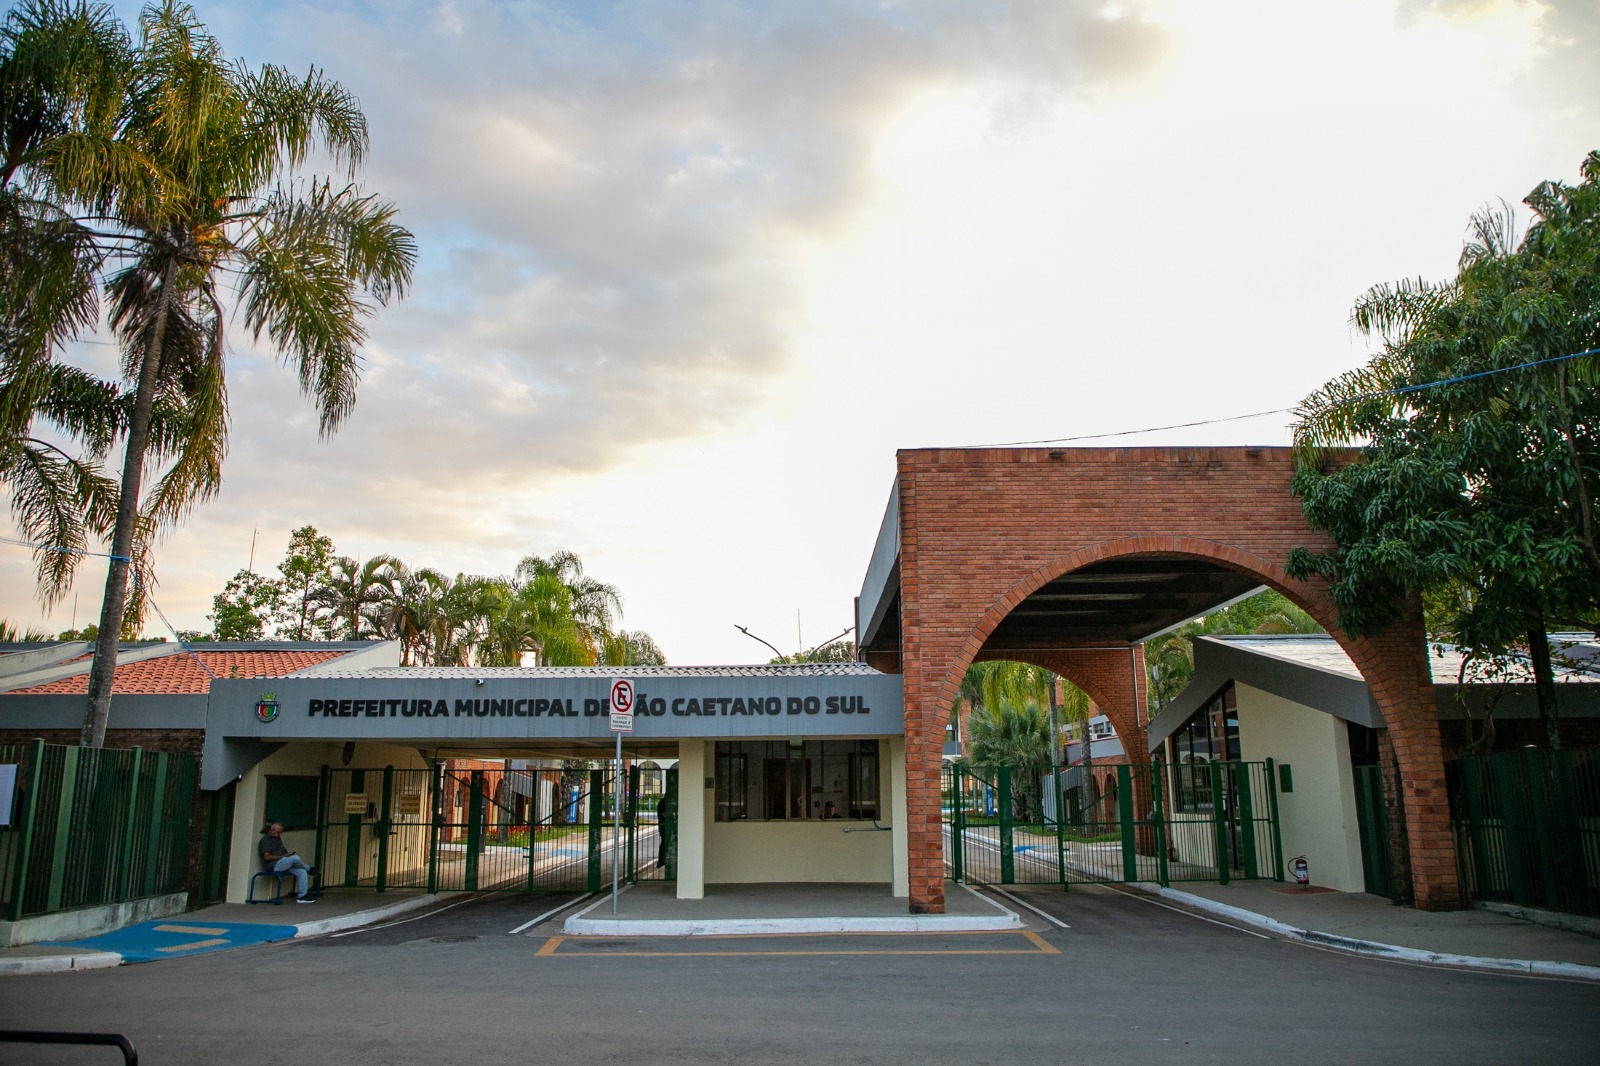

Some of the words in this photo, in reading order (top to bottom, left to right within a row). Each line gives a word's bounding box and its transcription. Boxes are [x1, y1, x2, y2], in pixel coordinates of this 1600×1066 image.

[308, 698, 449, 718] PREFEITURA
[455, 698, 579, 718] MUNICIPAL
[584, 698, 610, 718] DE
[633, 694, 667, 717] ÃO
[672, 697, 782, 717] CAETANO
[786, 697, 821, 716] DO
[825, 696, 871, 715] SUL
